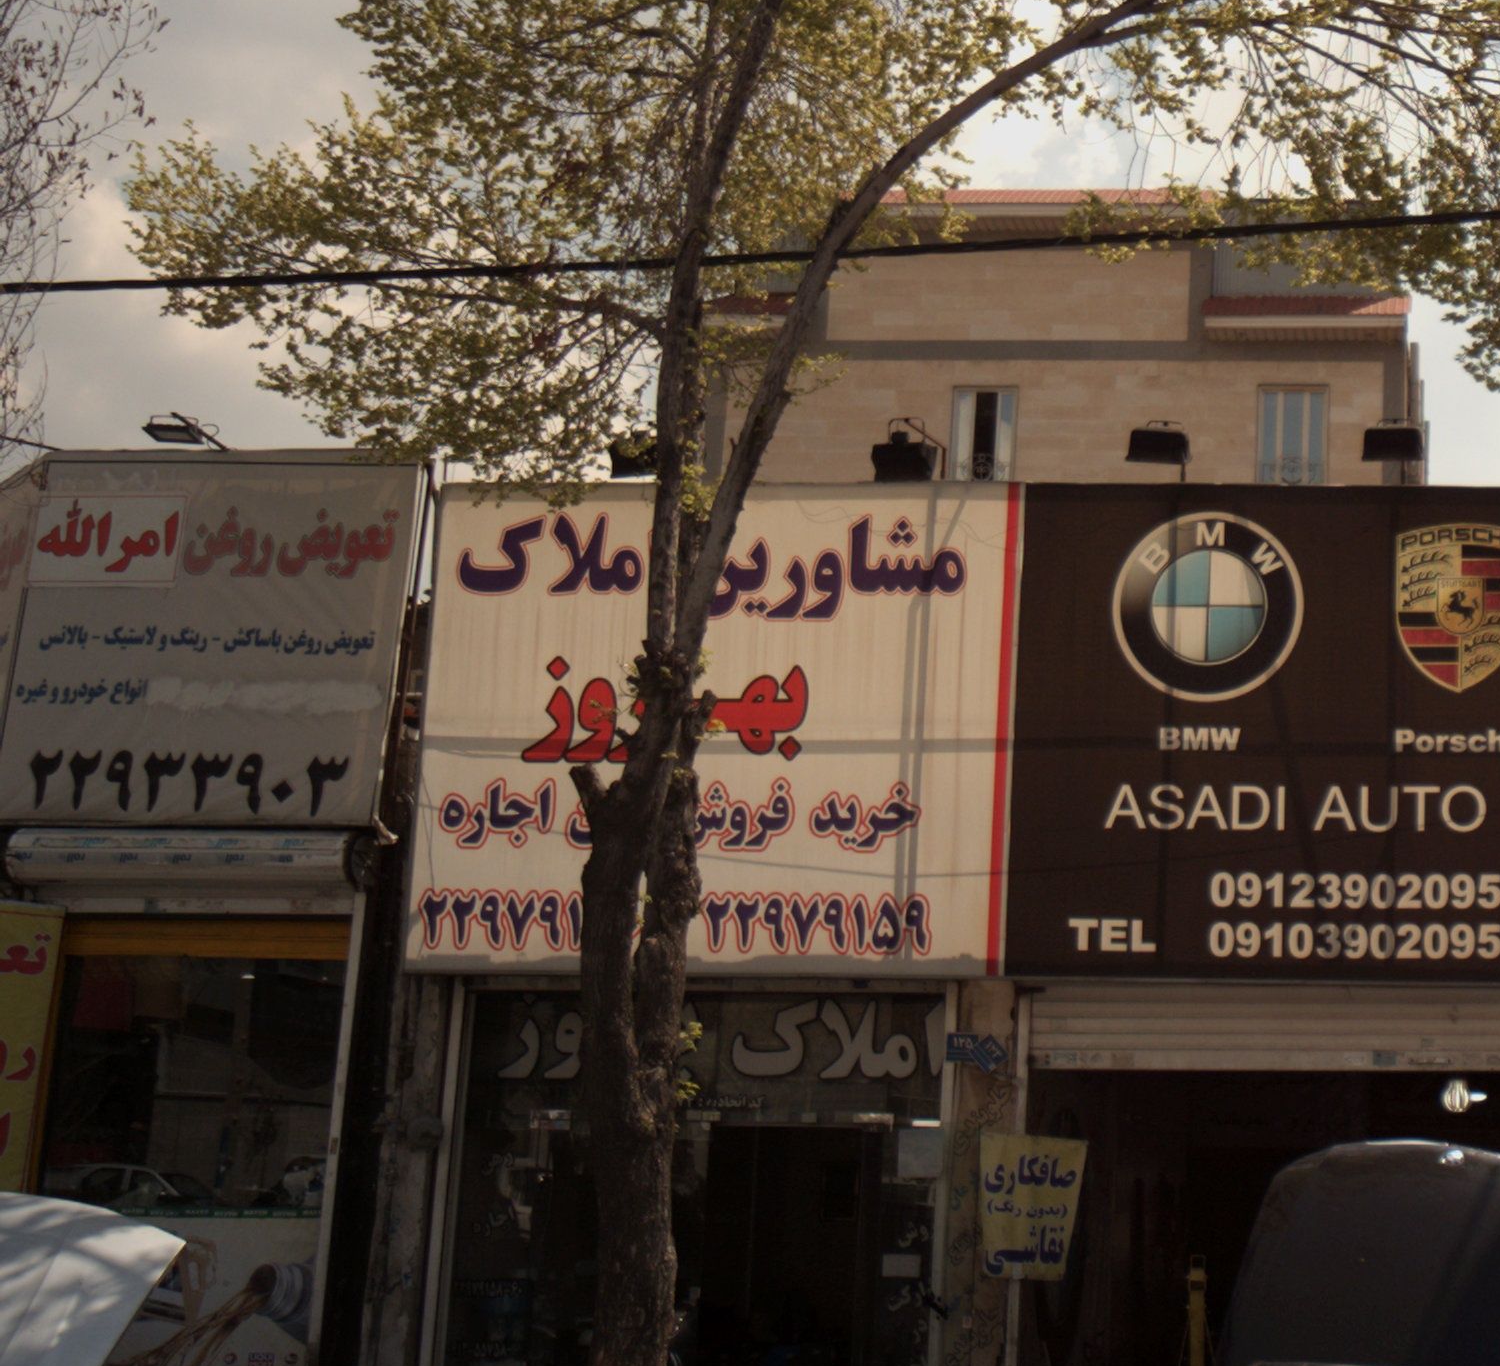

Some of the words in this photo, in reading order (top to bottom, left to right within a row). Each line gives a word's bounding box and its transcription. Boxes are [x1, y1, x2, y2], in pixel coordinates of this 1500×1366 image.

[183, 505, 274, 577] روغن
[278, 507, 400, 580] تعویض
[458, 513, 650, 595] ملاک
[1139, 520, 1283, 578] BMW
[709, 517, 966, 621] مشاورین
[39, 625, 88, 651] بالانس
[104, 625, 157, 650] لاستیک
[170, 627, 208, 653] رینگ
[283, 629, 322, 655] روغن
[324, 630, 376, 655] تعویض
[15, 678, 49, 705] غیره
[60, 678, 107, 705] خودرو
[109, 678, 149, 705] انواع
[521, 655, 809, 763] بهوز
[1158, 727, 1241, 752] BMW
[30, 749, 350, 818] ۲۲۹۳۳۹۰۳
[439, 777, 557, 849] اجاره
[694, 778, 797, 852] فروش
[811, 781, 920, 852] خرید
[1104, 785, 1286, 831] ASADI
[1313, 785, 1487, 833] AUTO
[419, 889, 584, 952] ۲۲۹۷۹۱
[702, 891, 931, 956] ۲۲۹۷۹۱۵۹
[1068, 917, 1156, 954] TEL
[731, 998, 946, 1079] املاک
[985, 1153, 1077, 1195] صافکاری
[984, 1225, 1065, 1275] نقاشی
